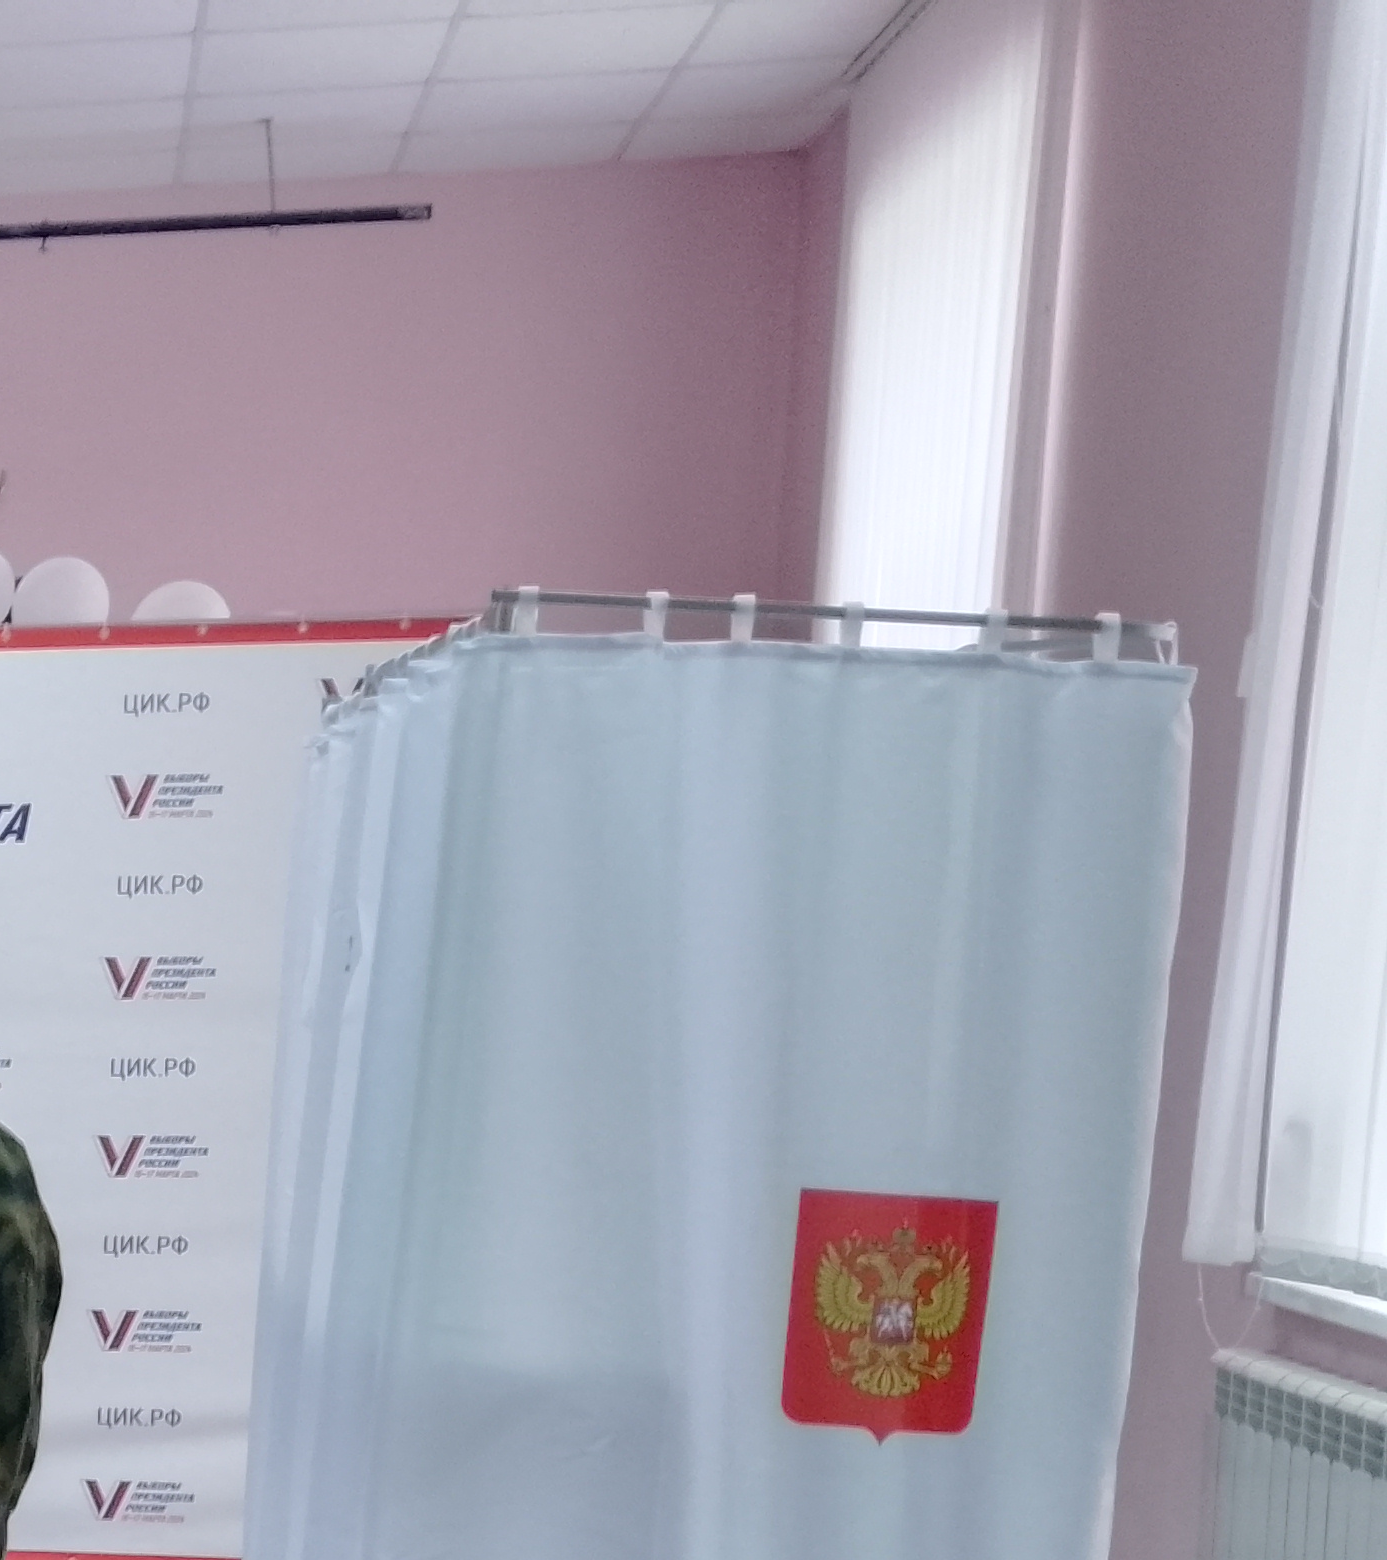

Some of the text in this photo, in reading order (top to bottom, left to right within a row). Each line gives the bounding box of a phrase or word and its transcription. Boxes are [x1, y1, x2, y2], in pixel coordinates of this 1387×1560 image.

[124, 692, 210, 717] ЦИК.РФ
[118, 874, 203, 899] ЦИК.РФ
[111, 1057, 195, 1081] ЦИК.РФ
[104, 1235, 188, 1258] ЦИК.РФ
[97, 1407, 182, 1429] ЦИК.РФ
